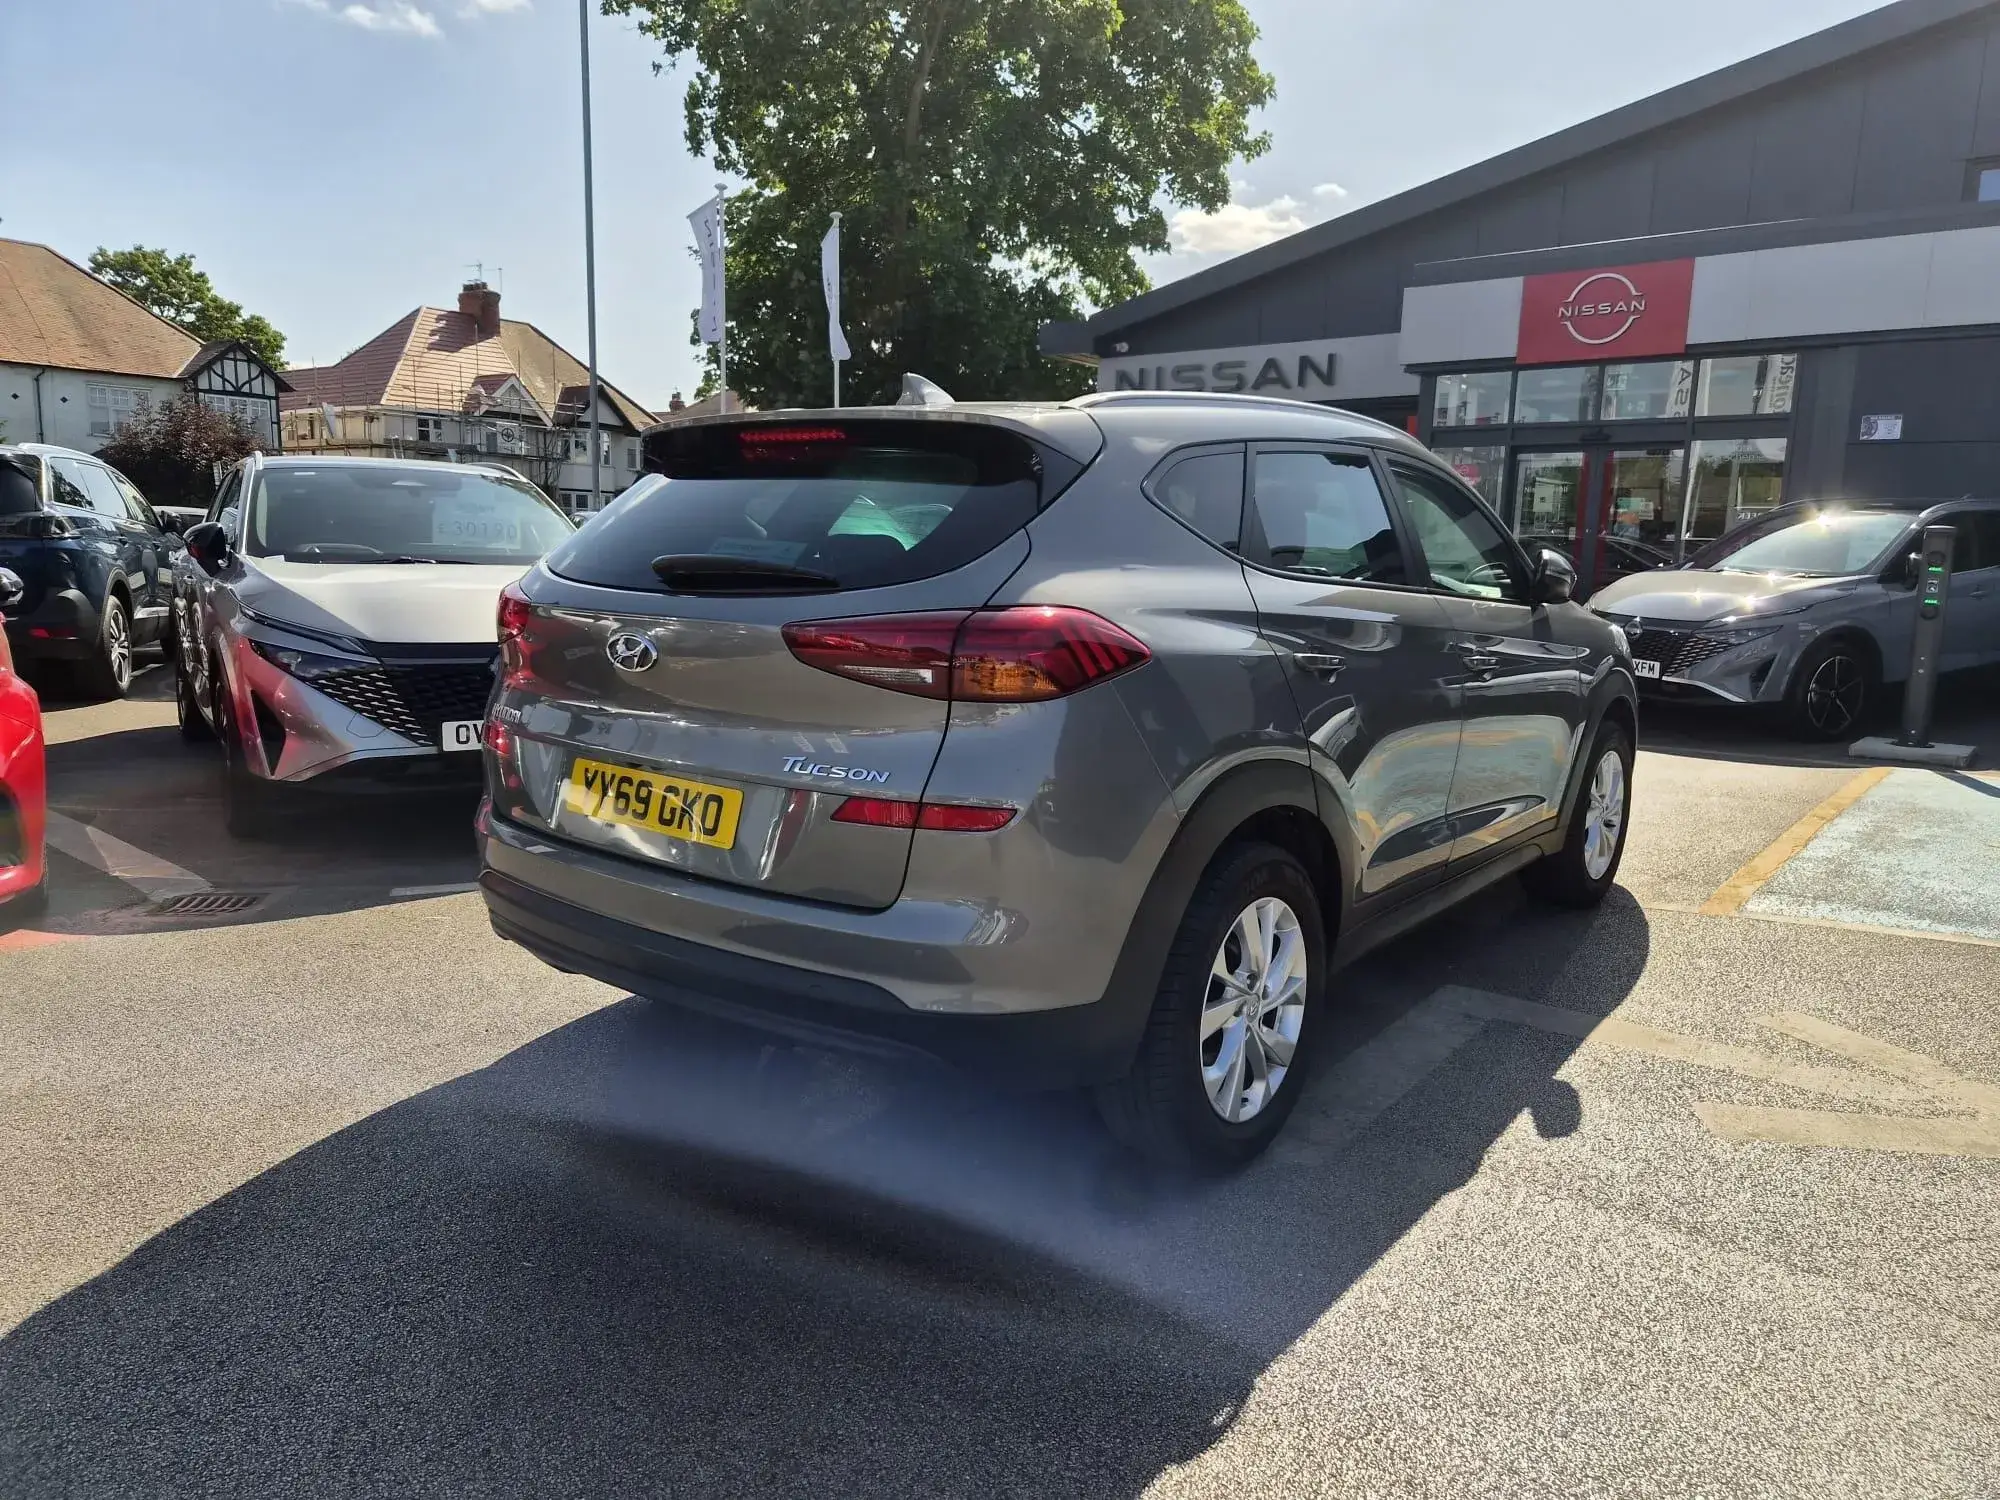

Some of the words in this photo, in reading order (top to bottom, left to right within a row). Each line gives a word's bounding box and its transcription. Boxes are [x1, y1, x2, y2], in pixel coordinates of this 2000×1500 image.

[1558, 299, 1645, 318] NISSAN
[1115, 353, 1337, 392] NISSAN
[1634, 660, 1655, 675] XFM
[782, 756, 890, 783] TUCSON
[583, 767, 652, 820] YY69
[658, 784, 724, 837] GKO
